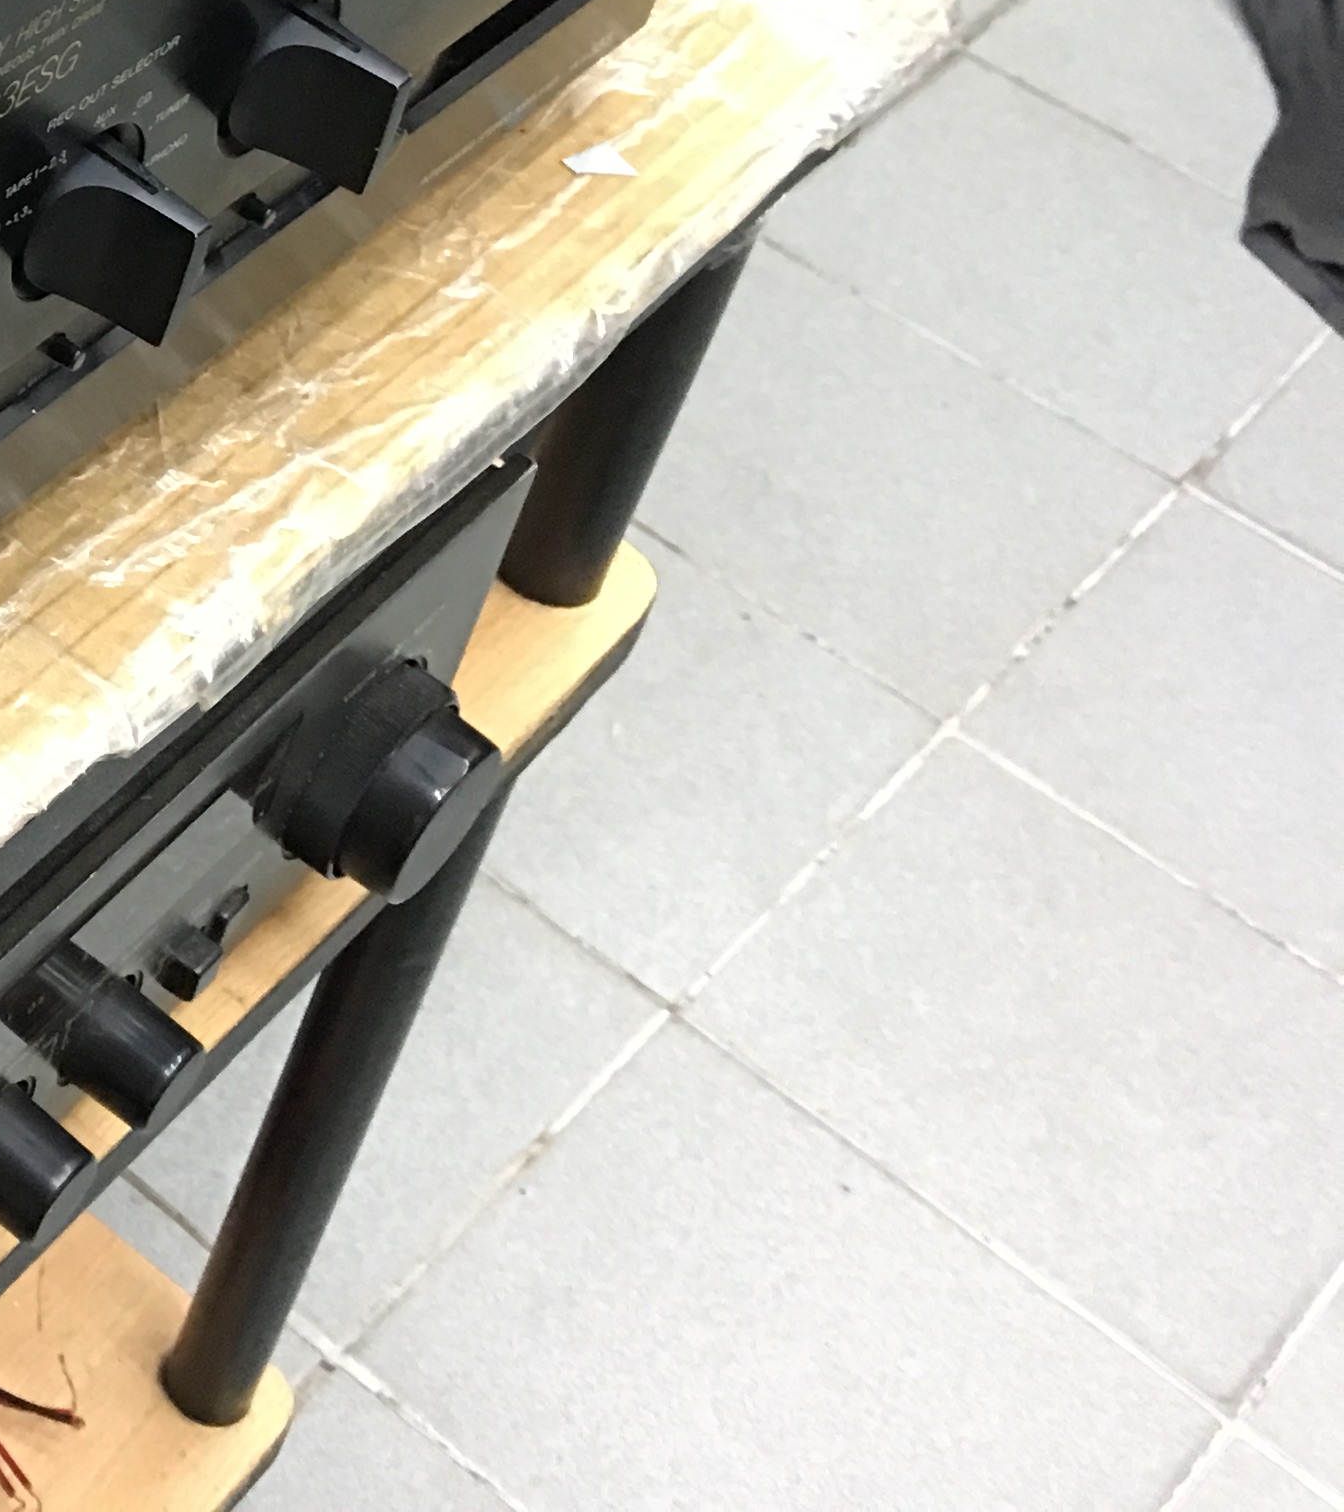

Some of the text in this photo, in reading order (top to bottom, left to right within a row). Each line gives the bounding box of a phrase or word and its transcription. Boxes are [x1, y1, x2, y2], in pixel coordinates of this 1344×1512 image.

[15, 0, 66, 48] HIGH
[46, 35, 181, 133] REC OUT SELECTOR
